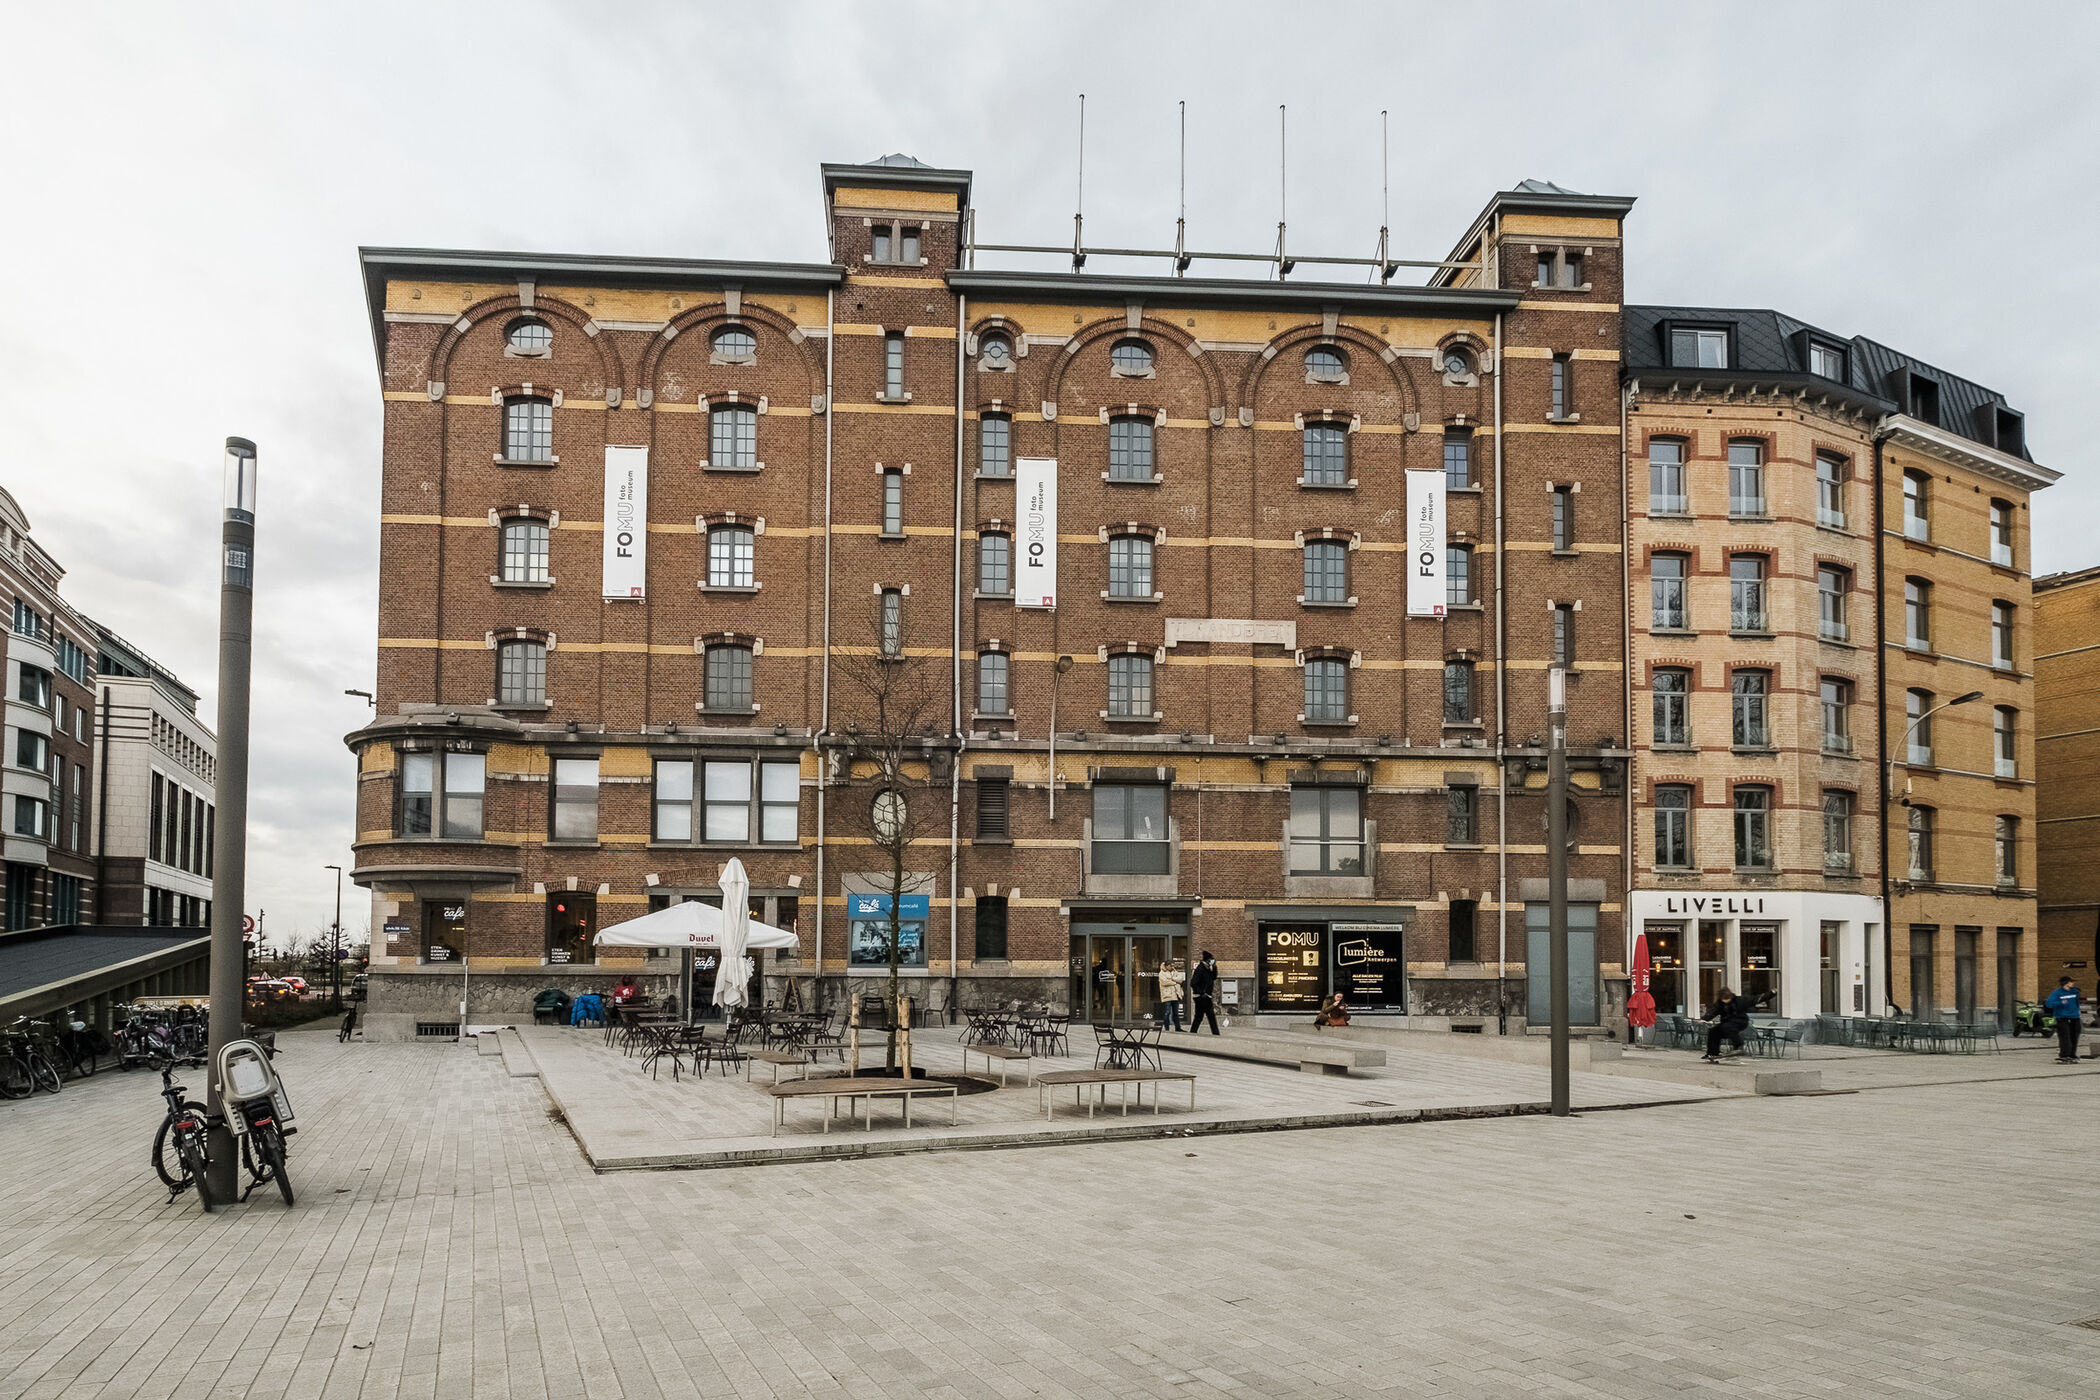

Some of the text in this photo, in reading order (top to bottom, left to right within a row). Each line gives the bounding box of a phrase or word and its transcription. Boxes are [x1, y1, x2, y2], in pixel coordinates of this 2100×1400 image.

[616, 501, 634, 558] FOMU
[1029, 512, 1044, 567] FOMU
[1419, 523, 1434, 577] FOMU
[1667, 898, 1763, 913] LIVELLI
[689, 933, 714, 942] Duvel
[1267, 932, 1319, 946] FOMU
[1344, 946, 1384, 956] lumière
